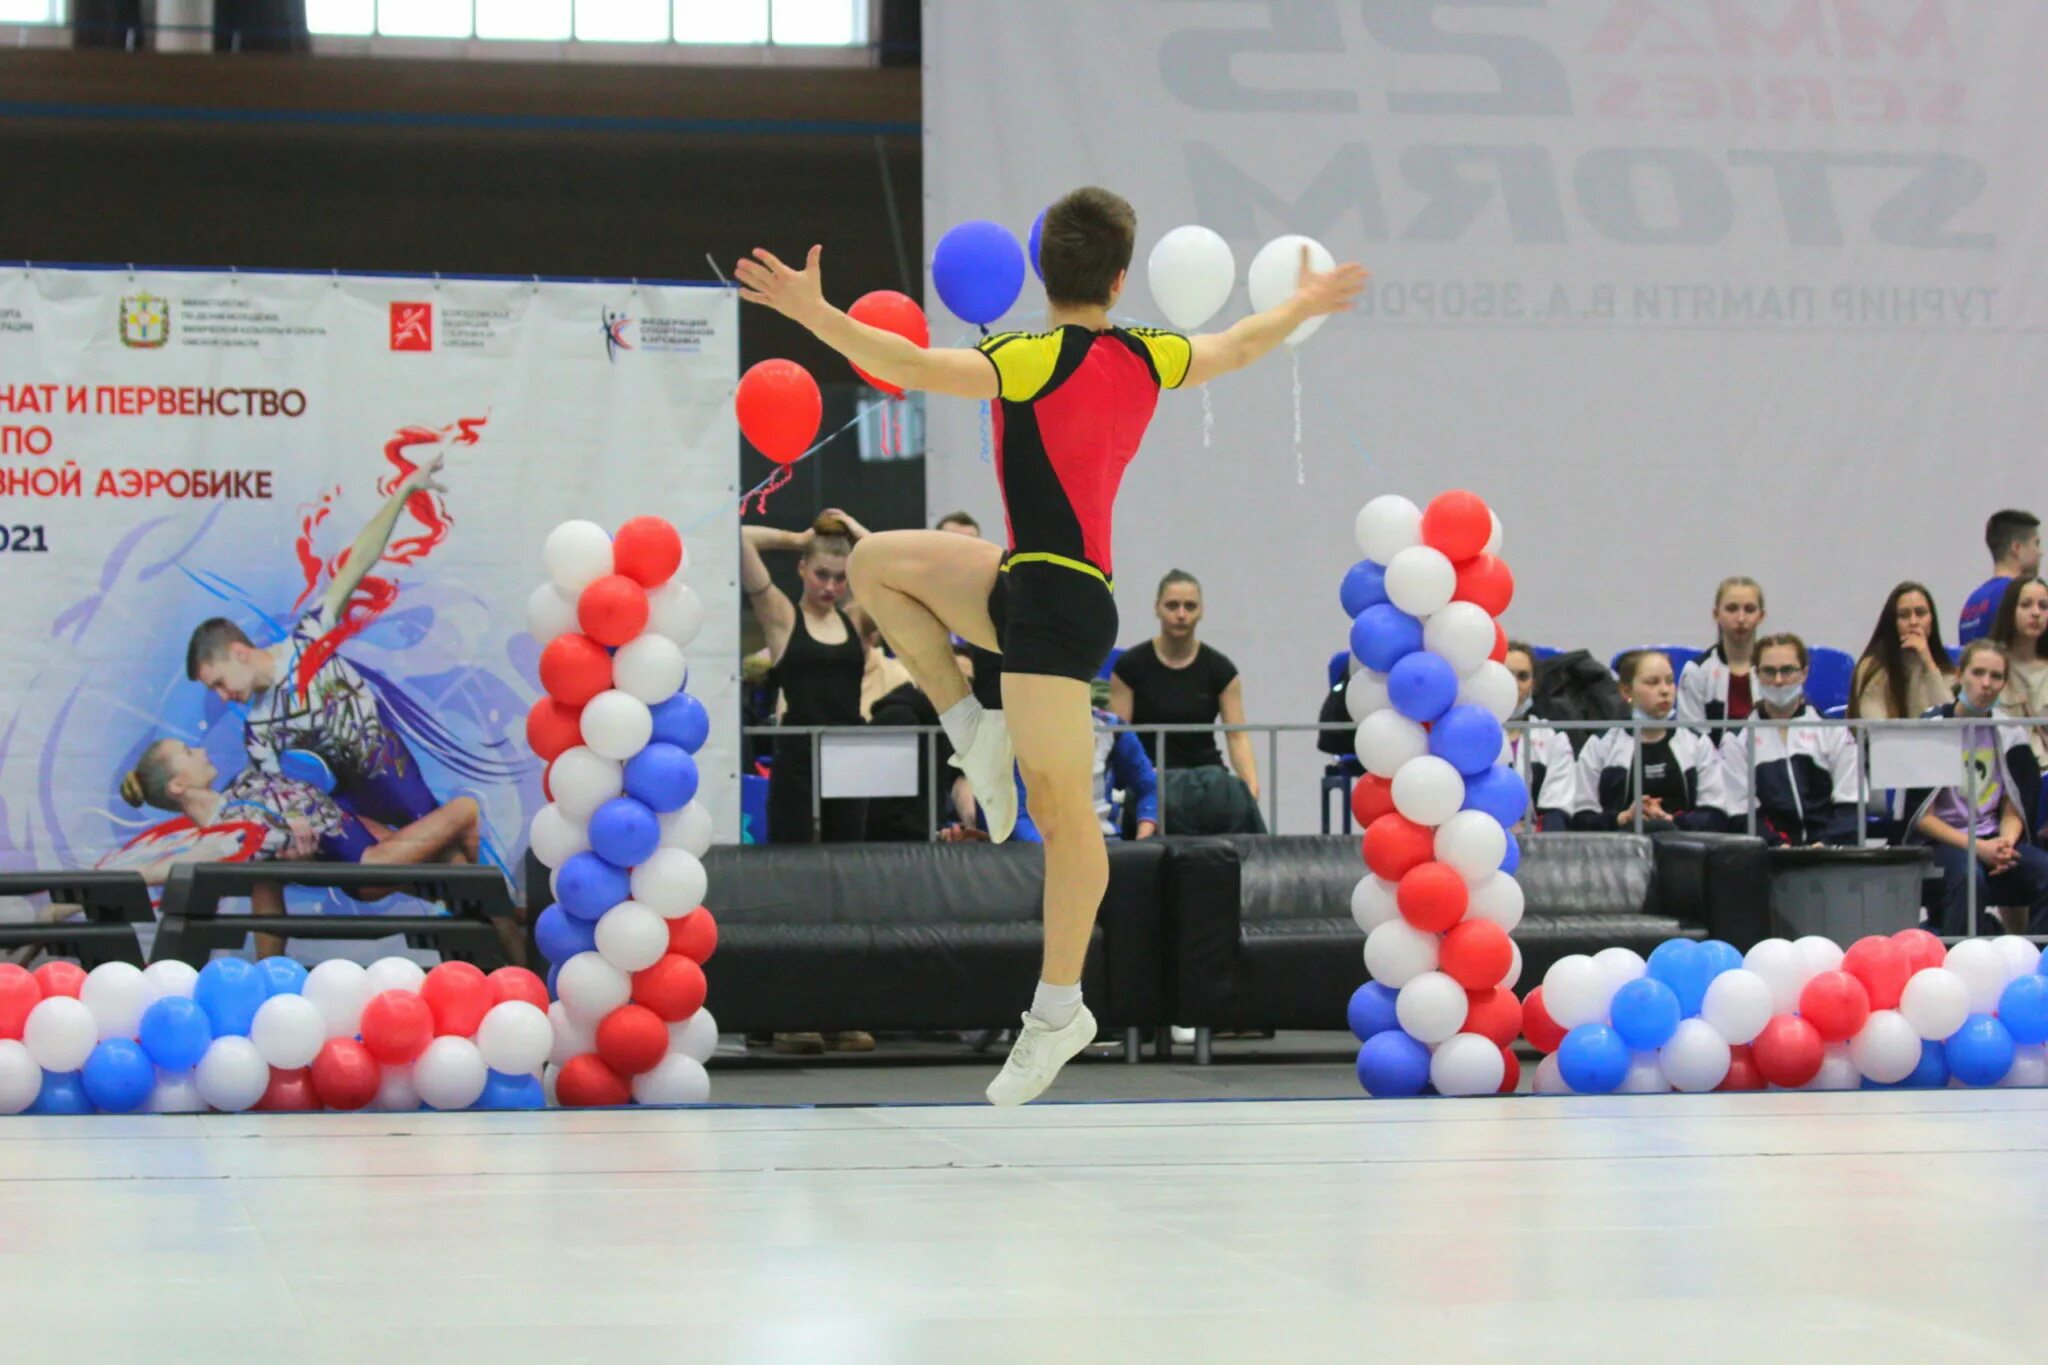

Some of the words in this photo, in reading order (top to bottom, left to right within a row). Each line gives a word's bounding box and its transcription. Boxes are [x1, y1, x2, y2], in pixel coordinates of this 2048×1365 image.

[66, 385, 88, 414] И
[95, 386, 307, 417] ПЕРВЕНСТВО
[2, 425, 53, 456] ПО
[94, 467, 273, 498] АЭРОБИКЕ
